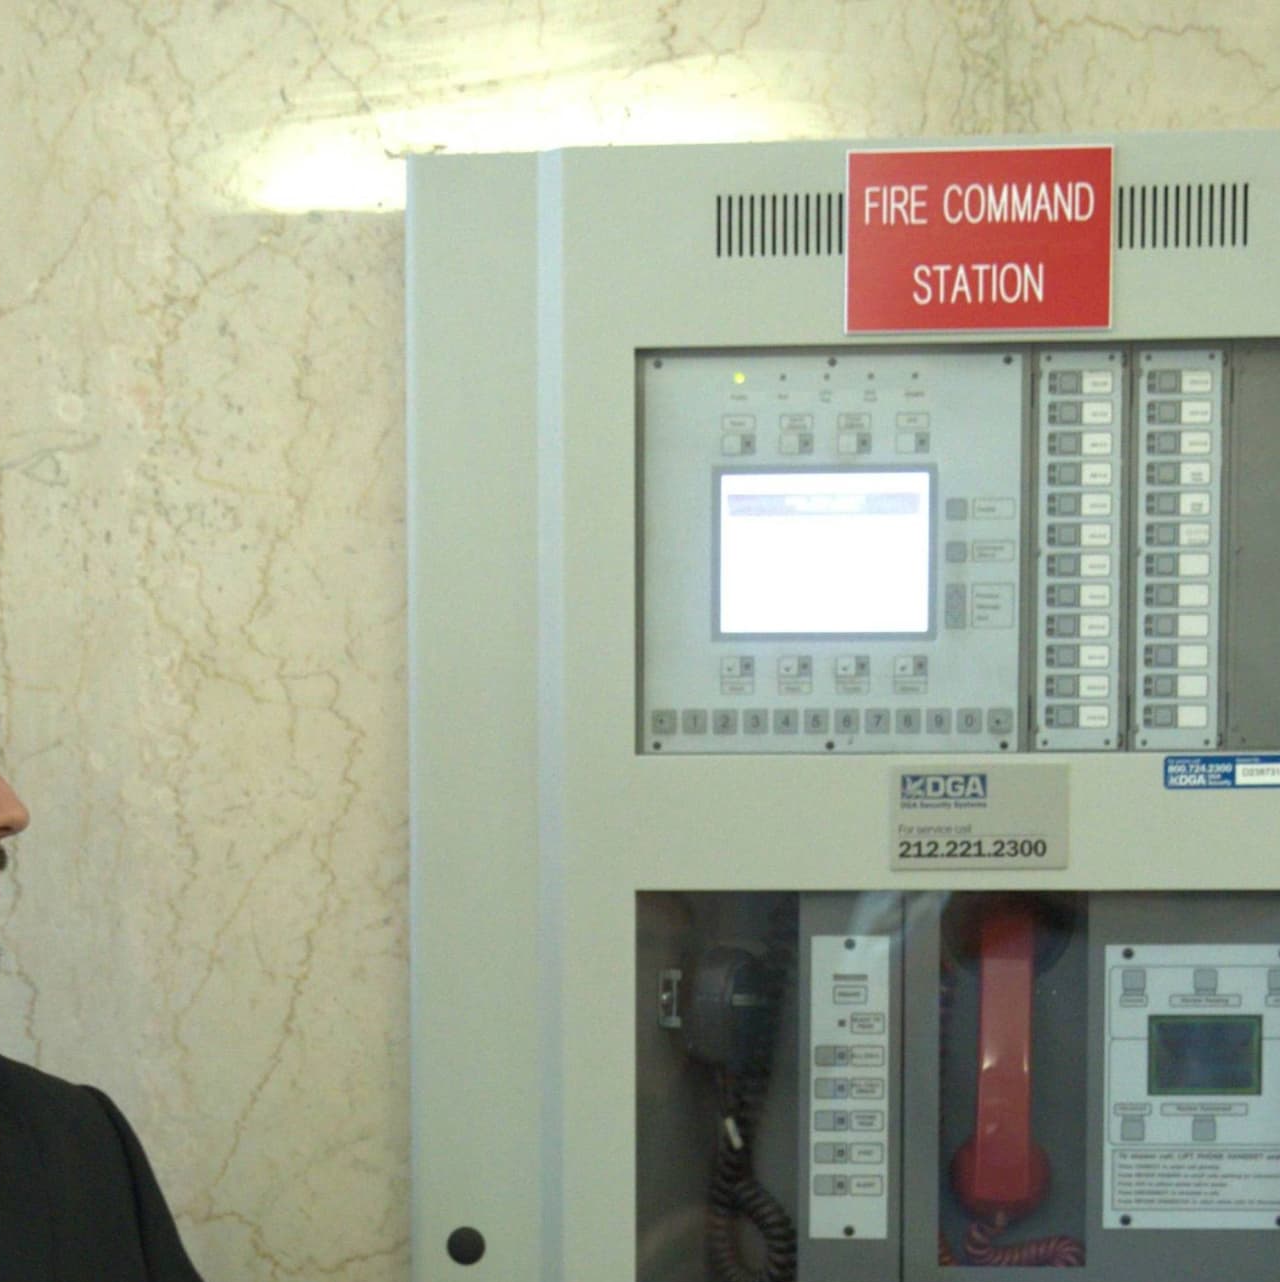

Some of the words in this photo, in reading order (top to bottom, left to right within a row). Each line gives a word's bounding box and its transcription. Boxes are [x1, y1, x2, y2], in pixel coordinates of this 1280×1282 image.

[864, 185, 928, 226] FIRE
[942, 182, 1095, 224] COMMAND
[912, 263, 1045, 305] STATION
[692, 715, 698, 728] 1
[721, 715, 730, 728] 2
[751, 715, 760, 728] 3
[781, 715, 791, 728] 4
[811, 715, 821, 728] 5
[843, 715, 851, 728] 6
[873, 715, 882, 728] 7
[965, 715, 973, 728] 0
[898, 839, 1047, 859] 212.221.2300
